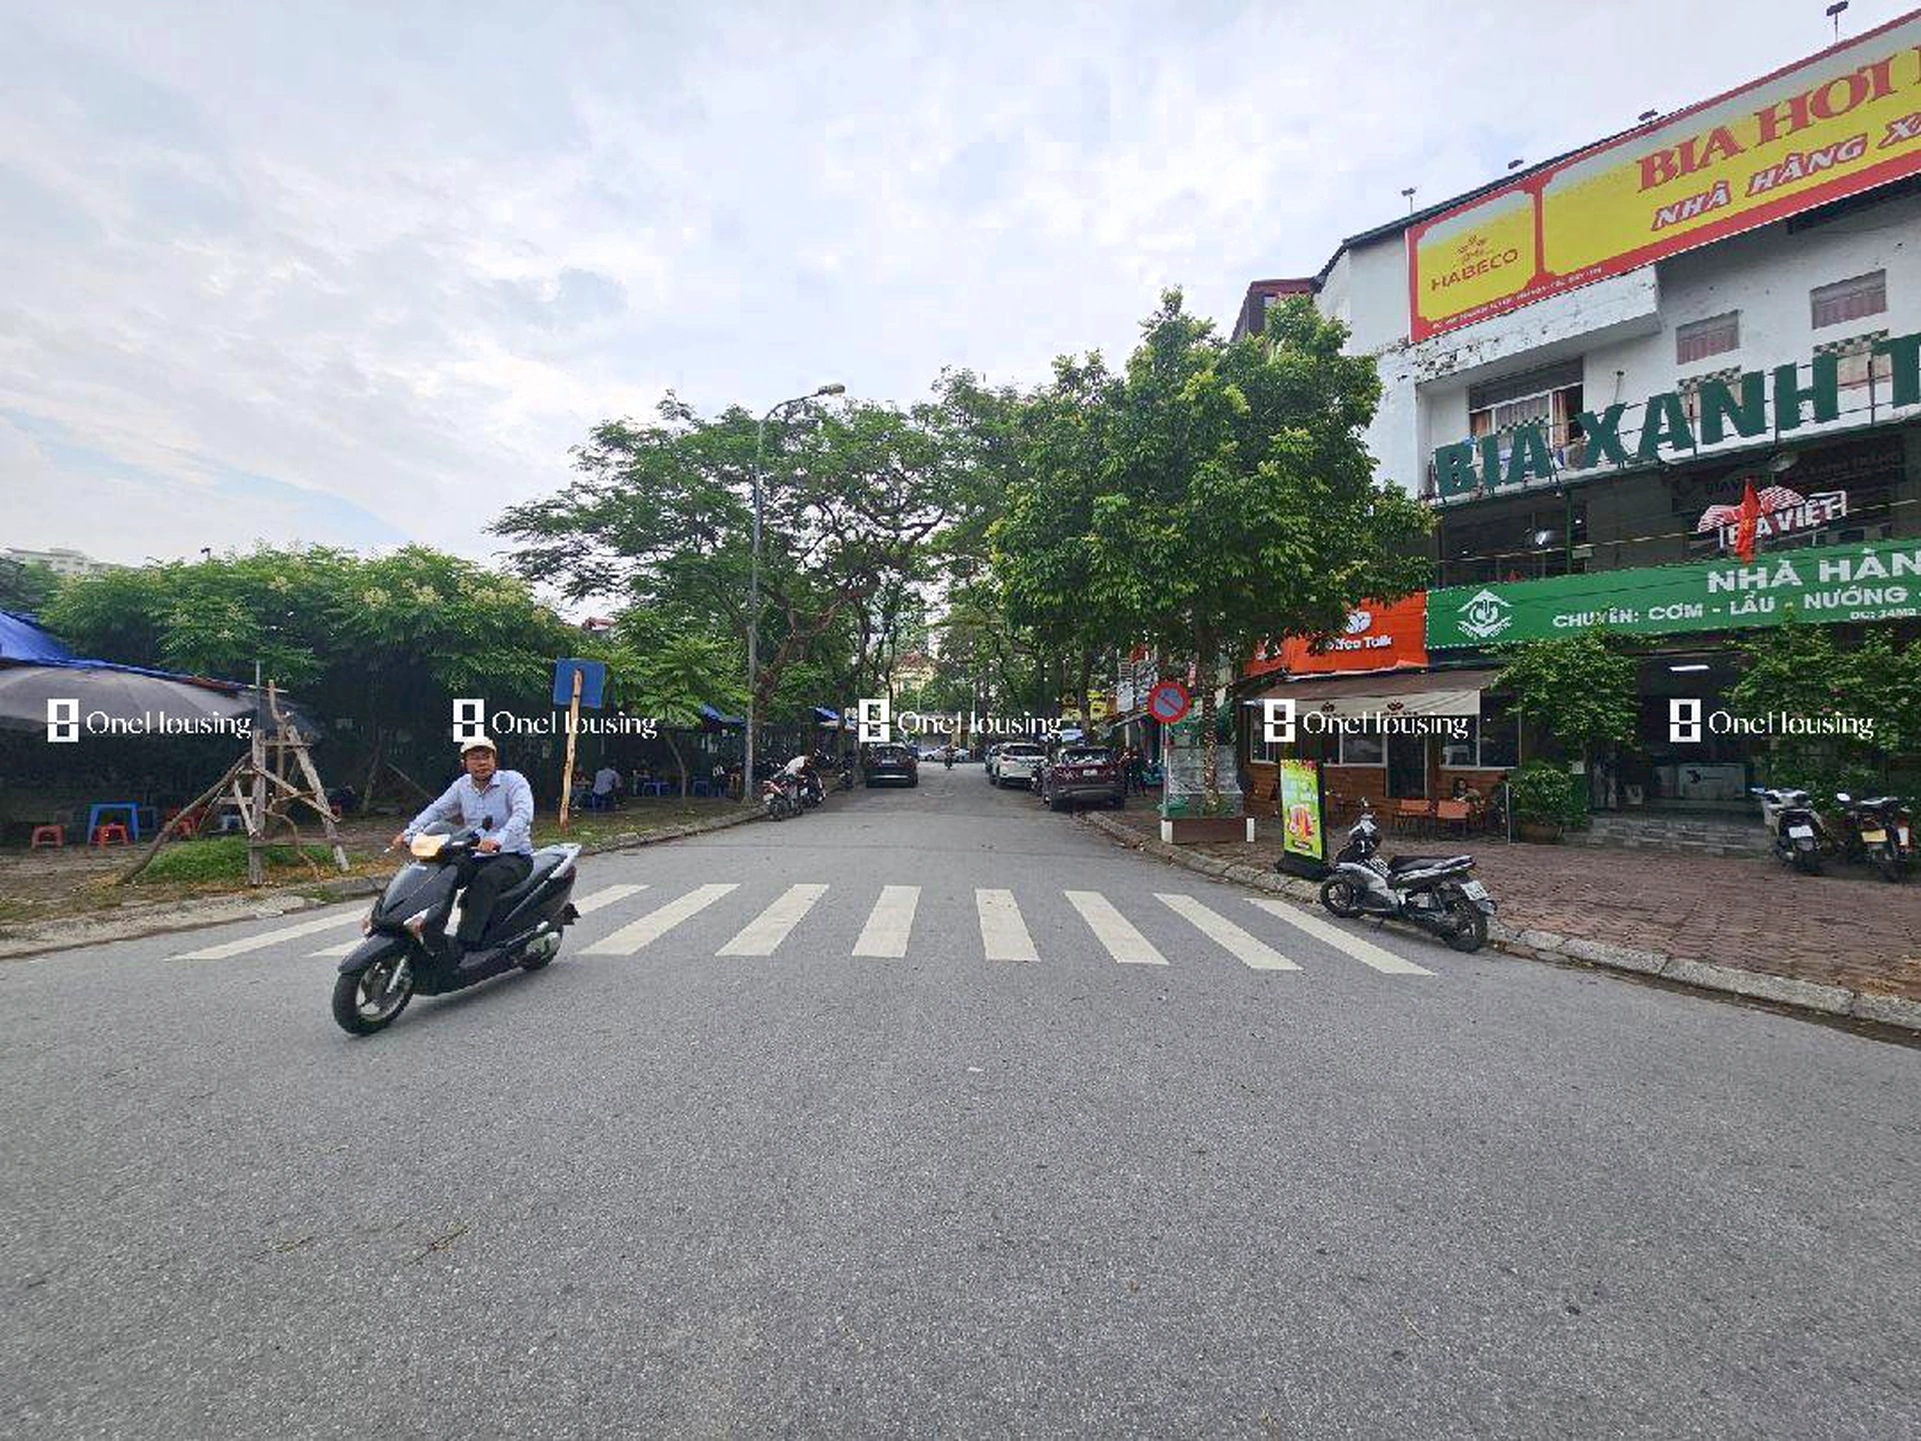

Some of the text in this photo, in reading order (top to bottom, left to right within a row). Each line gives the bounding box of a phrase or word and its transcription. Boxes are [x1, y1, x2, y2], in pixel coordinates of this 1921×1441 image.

[1636, 126, 1746, 192] BIA
[1430, 249, 1519, 292] HABECO
[1434, 423, 1553, 497] BIA
[1574, 350, 1840, 468] XANH
[1708, 557, 1803, 593] NHÀ
[1649, 602, 1703, 620] CƠM
[1804, 585, 1908, 610] NƯỚNG
[1363, 634, 1394, 649] Talk
